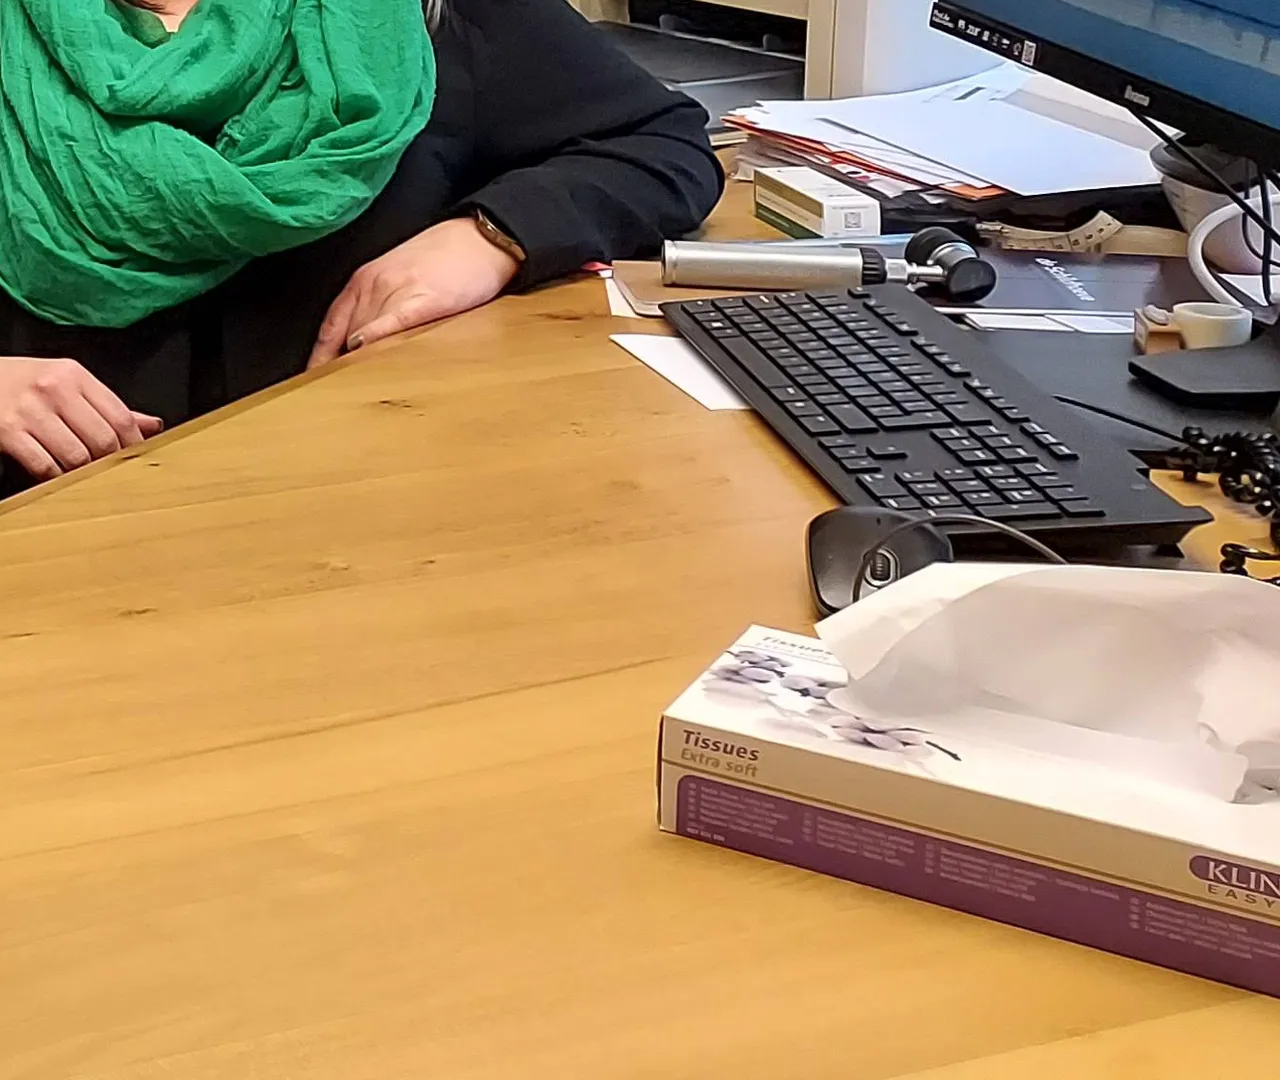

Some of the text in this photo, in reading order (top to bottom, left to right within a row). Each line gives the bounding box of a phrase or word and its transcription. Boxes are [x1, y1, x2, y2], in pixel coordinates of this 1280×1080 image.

[680, 747, 759, 779] Extra soft
[682, 728, 760, 764] Tissues
[1206, 860, 1280, 898] KLIN
[1207, 883, 1278, 910] EASY
